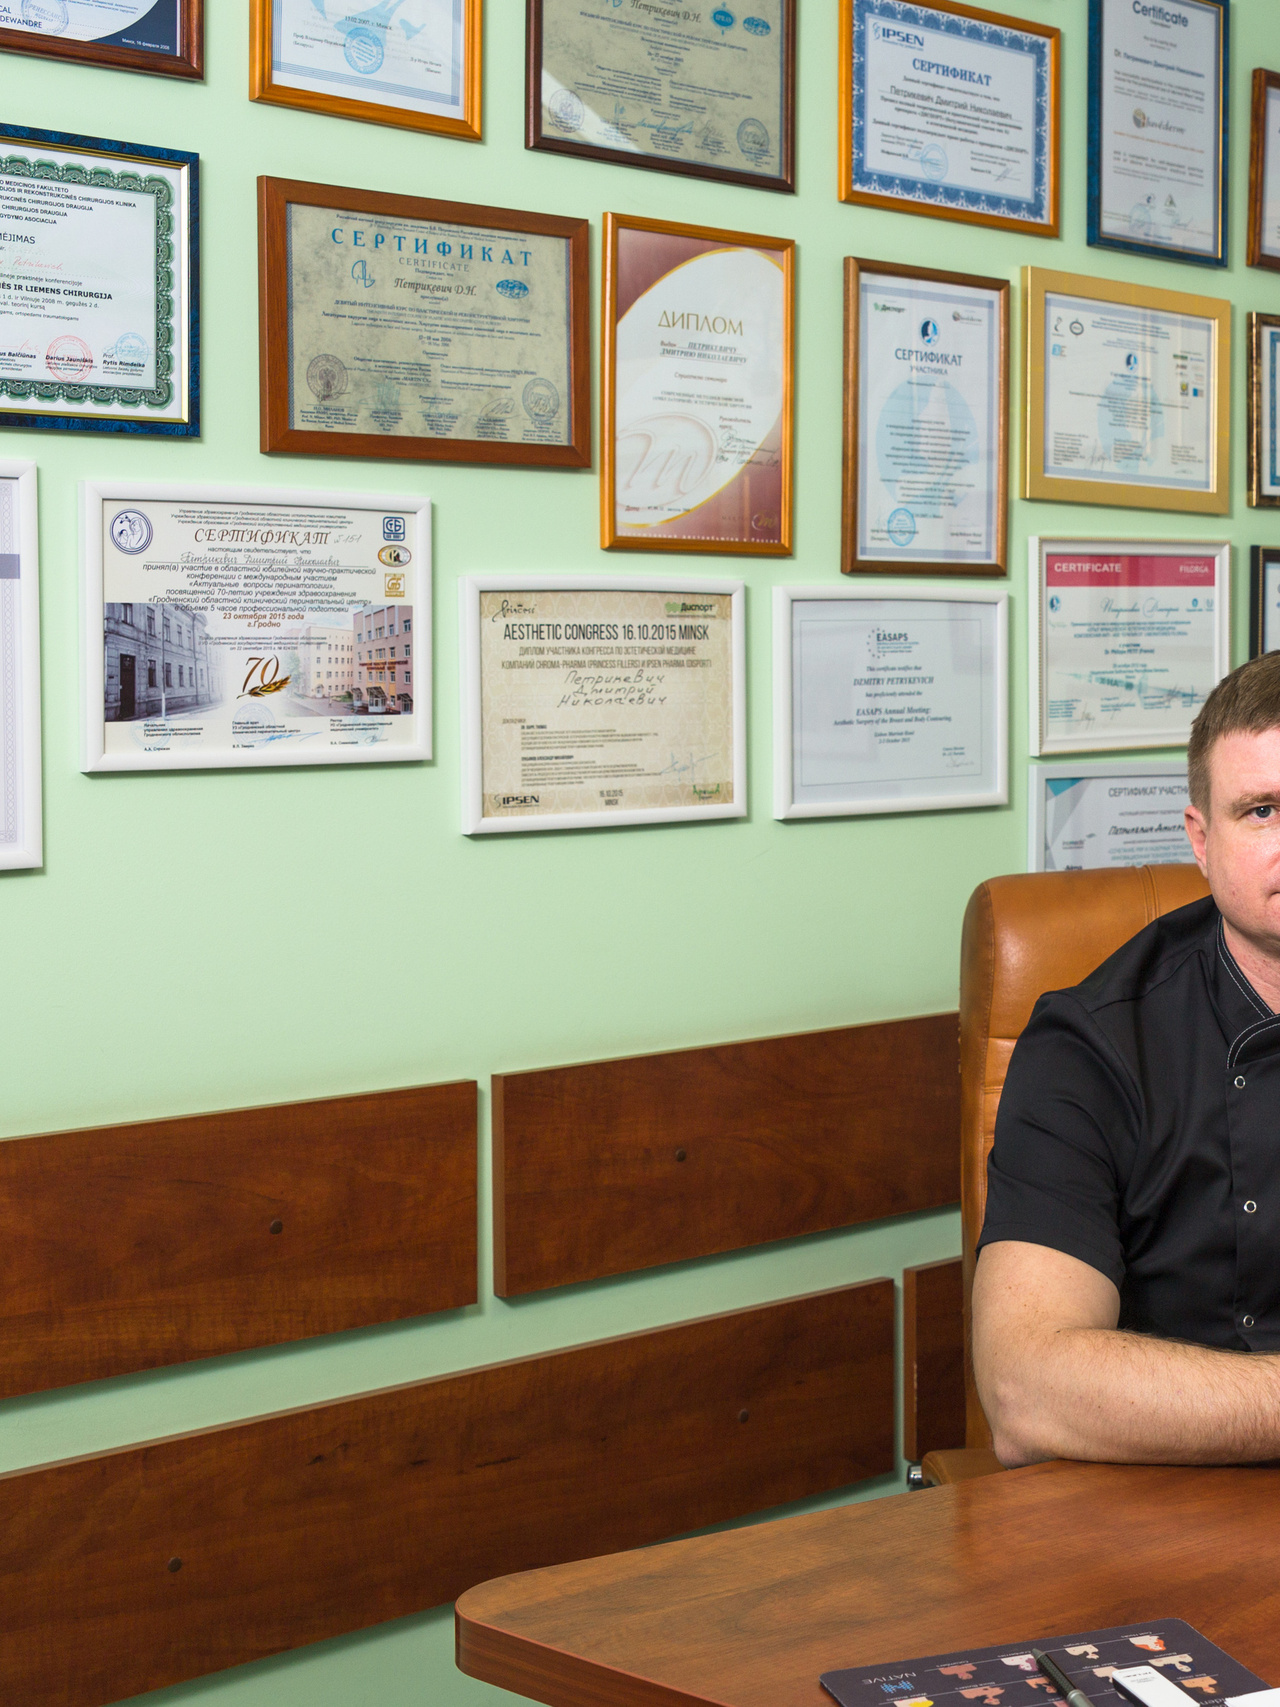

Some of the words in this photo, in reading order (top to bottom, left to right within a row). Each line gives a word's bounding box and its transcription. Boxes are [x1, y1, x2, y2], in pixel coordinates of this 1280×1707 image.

[683, 9, 701, 23] Д.Н.
[1133, 1, 1188, 27] Certificate
[882, 28, 924, 47] IPSEN
[913, 57, 992, 87] СЕРТИФИКАТ
[5, 181, 35, 189] MEDICINOS
[37, 184, 68, 193] FAKULTETO
[28, 199, 64, 208] CHIRURGIJOS
[66, 203, 93, 211] DRAUGIJA
[78, 196, 114, 205] CHIRURGIJOS
[116, 200, 136, 208] KLINIKA
[2, 205, 39, 214] CHIRURGIJOS
[40, 209, 67, 217] DRAUGIJA
[25, 216, 57, 224] ASOCIACIJA
[332, 228, 532, 267] СЕРТИФИКАТ
[399, 256, 469, 272] CERTIFICATE
[26, 285, 61, 295] LIEMENS
[63, 288, 112, 300] CHIRURGIJA
[394, 277, 452, 294] Петрикевич
[455, 283, 477, 296] Д.Н.
[42, 297, 55, 305] 2008
[658, 310, 743, 336] ДИПЛОМ
[895, 348, 963, 366] СЕРТИФИКАТ
[195, 528, 331, 546] СЕРТИФИКАТ
[143, 564, 178, 572] принял(а)
[221, 565, 260, 573] областной
[262, 566, 301, 574] юбилейной
[303, 567, 376, 575] научно-практической
[1054, 563, 1122, 573] CERTIFICATE
[187, 573, 236, 581] конференции
[243, 574, 301, 582] международным
[275, 582, 335, 590] перинатологии»,
[308, 605, 349, 613] подготовки
[681, 603, 713, 612] Диспорт
[504, 624, 562, 640] AESTHETIC
[565, 624, 618, 640] CONGRESS
[622, 624, 676, 640] 16.10.2015
[679, 625, 709, 640] MINSK
[877, 633, 908, 642] EASAPS
[519, 647, 544, 657] ДИПЛОМ
[545, 647, 580, 656] УЧАСТНИКА
[582, 646, 614, 656] КОНГРЕССА
[242, 655, 279, 692] 70
[853, 678, 885, 686] DZMITRY
[887, 677, 934, 685] PETRYKEVICH
[856, 708, 882, 716] EASAPS
[884, 707, 905, 716] Annual
[1108, 787, 1157, 797] СЕРТИФИКАТ
[502, 795, 539, 804] IPSEN
[862, 1672, 916, 1685] NATIVE
